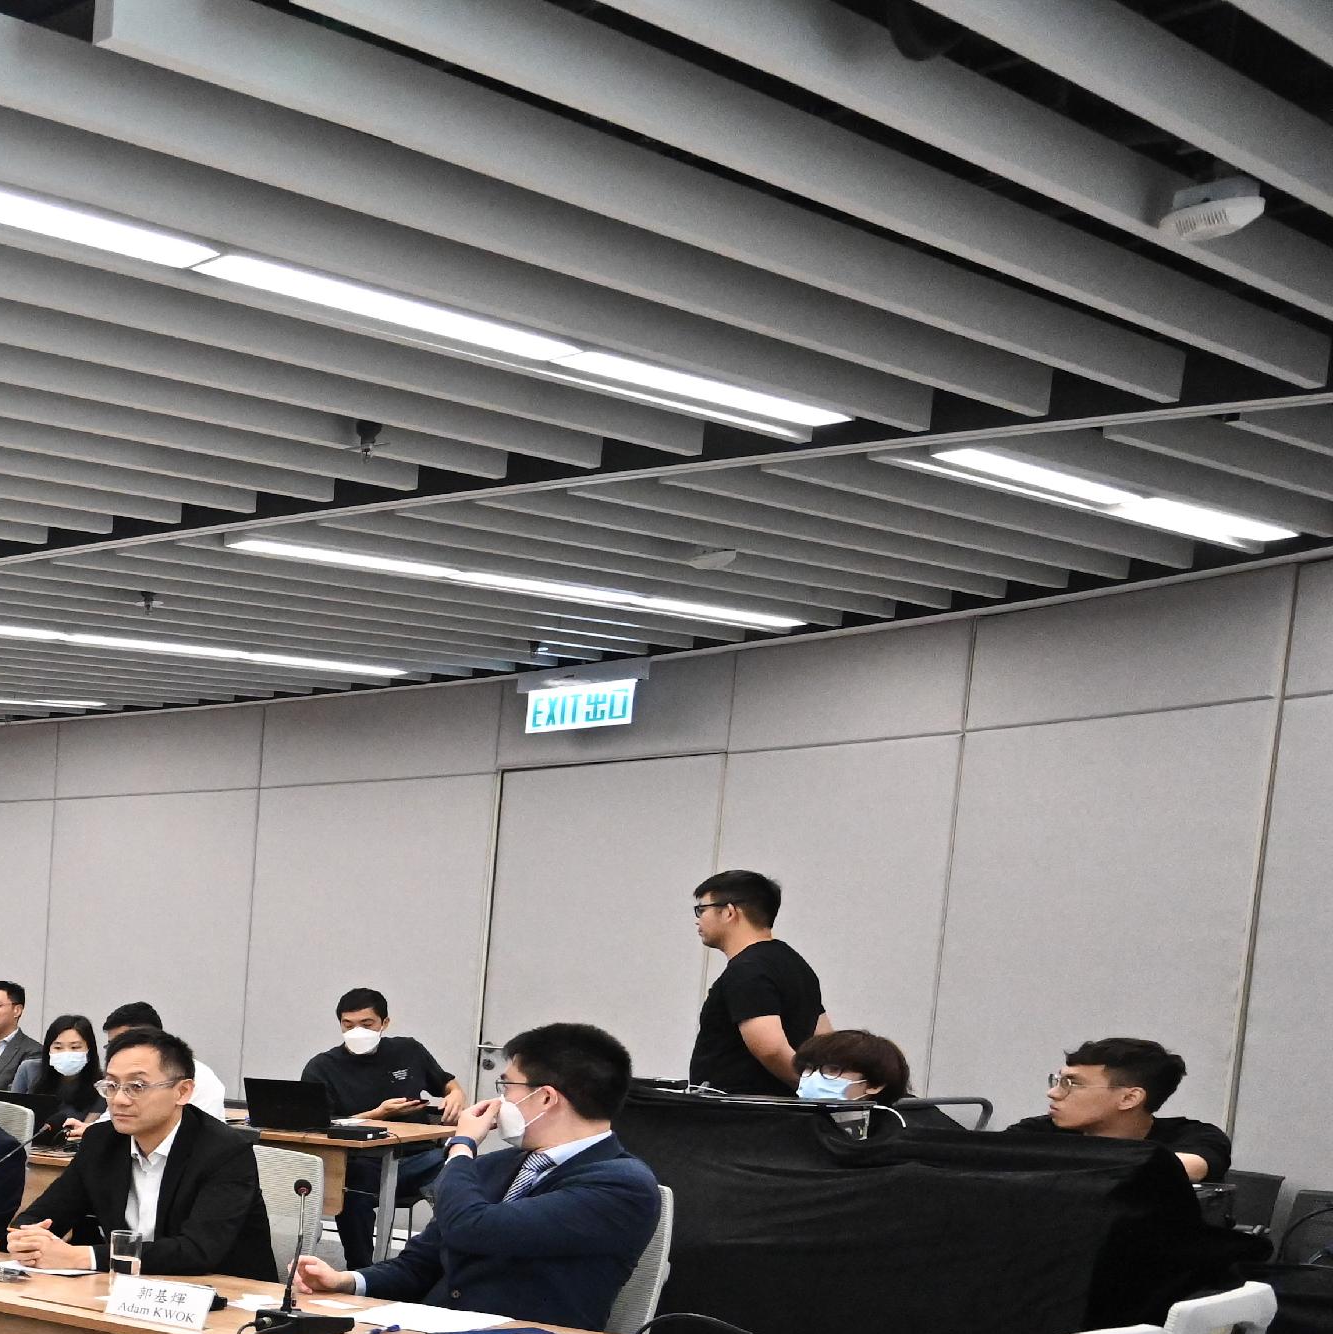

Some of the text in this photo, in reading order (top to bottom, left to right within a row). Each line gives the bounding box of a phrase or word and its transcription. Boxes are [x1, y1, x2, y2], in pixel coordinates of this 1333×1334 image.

[532, 688, 629, 727] EXIT 出口
[117, 1301, 197, 1324] Adam KWOK
